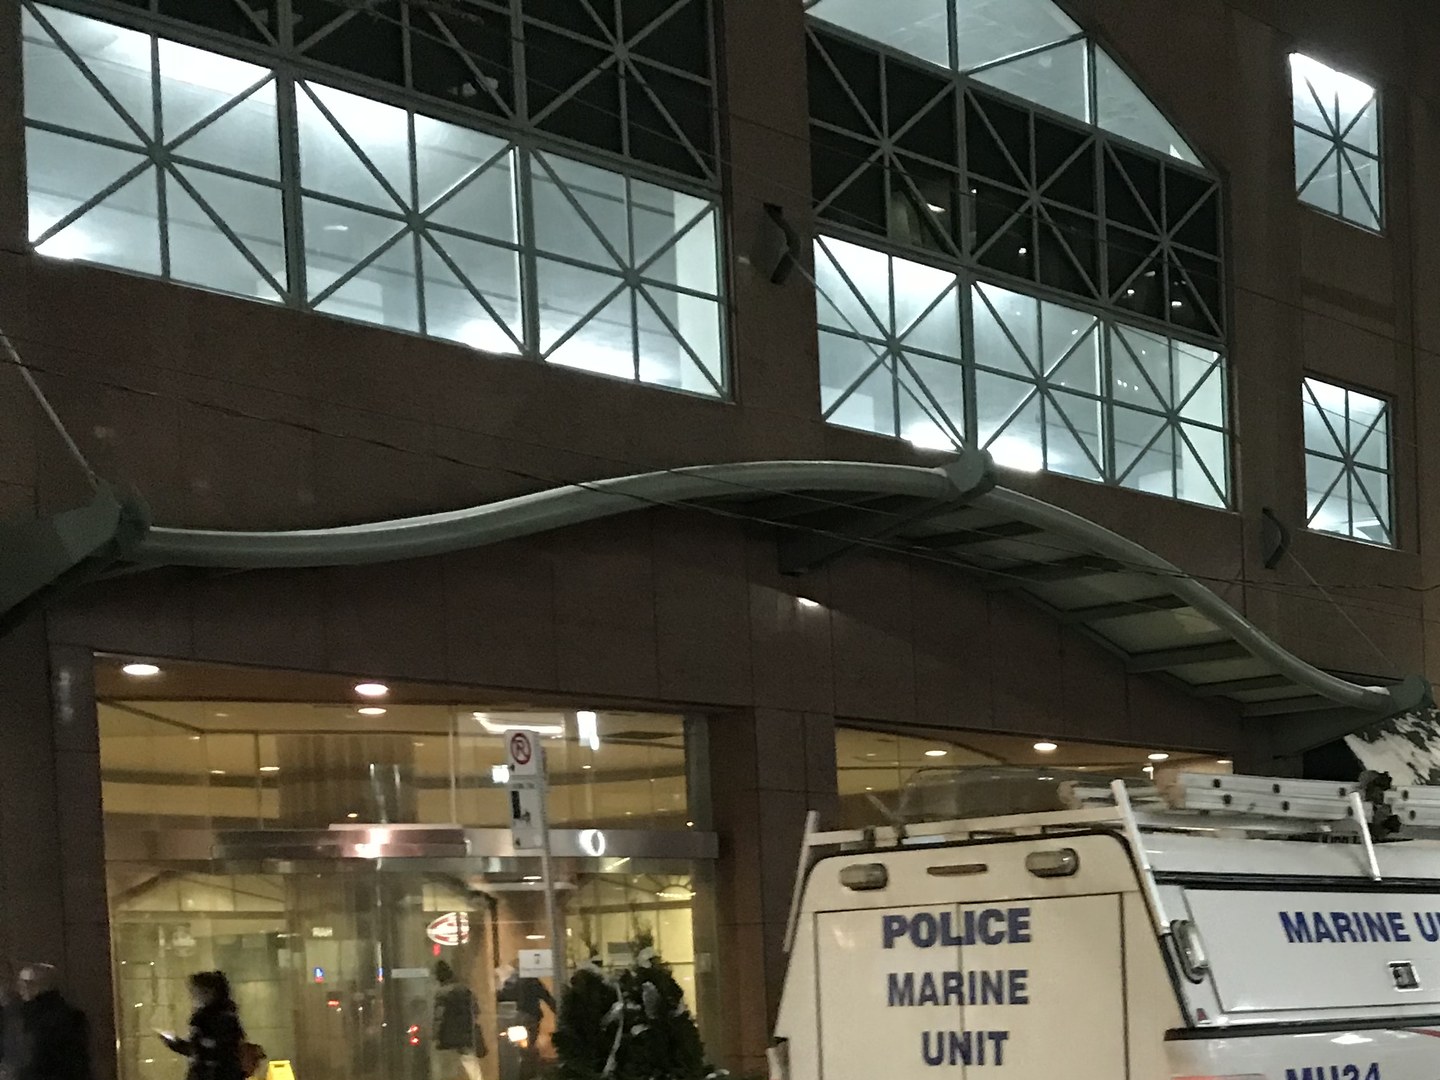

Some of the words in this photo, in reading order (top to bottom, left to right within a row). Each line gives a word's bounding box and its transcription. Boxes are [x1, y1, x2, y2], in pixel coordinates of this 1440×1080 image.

[882, 908, 1031, 948] POLICE
[1279, 911, 1411, 943] MARINE
[888, 969, 1030, 1006] MARINE
[922, 1030, 1009, 1066] UNIT
